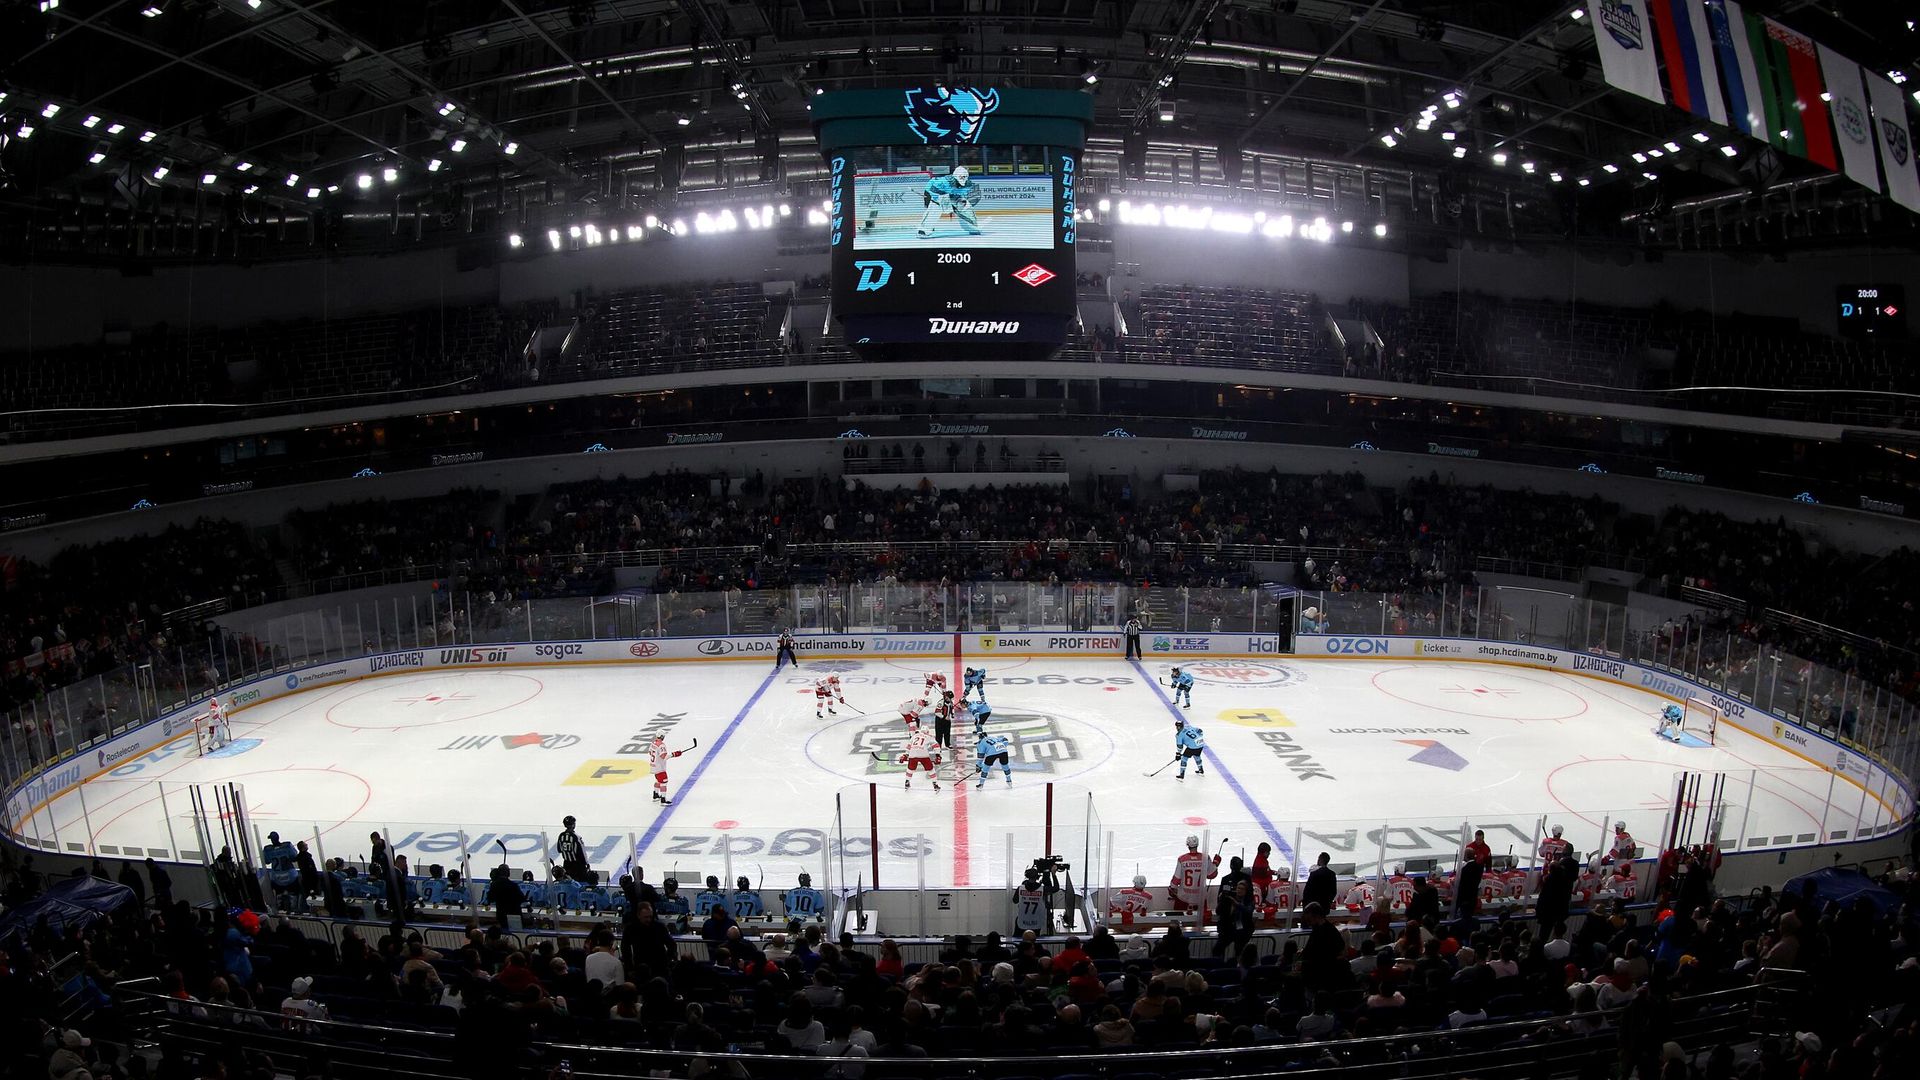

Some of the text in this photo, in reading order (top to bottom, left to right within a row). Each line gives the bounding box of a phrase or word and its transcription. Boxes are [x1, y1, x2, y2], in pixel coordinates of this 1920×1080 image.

[937, 253, 971, 264] 20:00
[907, 272, 915, 285] 1
[992, 272, 999, 285] 1
[1858, 289, 1878, 298] 20:00
[953, 301, 963, 309] nd
[1858, 307, 1862, 316] 1
[1875, 307, 1880, 316] 1
[737, 642, 774, 651] LADA
[873, 637, 946, 651] Dinamo
[999, 639, 1032, 647] BANK
[1173, 637, 1210, 645] TEZ
[1326, 638, 1389, 654] OZON
[535, 643, 582, 660] sogaz
[1478, 644, 1558, 664] shop.hcdinamo.by
[983, 674, 1135, 686] sogaz
[1711, 695, 1745, 719] sogaz
[1237, 713, 1272, 722] T
[615, 712, 688, 755] BANK
[1329, 727, 1470, 735] Rostelecom
[1775, 725, 1808, 748] T BANK
[913, 736, 925, 746] 21
[106, 742, 140, 763] Rostelecom
[1254, 731, 1337, 782] BANK
[591, 765, 632, 778] T
[27, 763, 80, 805] Dinamo
[663, 828, 934, 858] sogaz
[1301, 823, 1534, 852] LADA
[1184, 869, 1201, 887] 67
[424, 887, 433, 901] 9
[795, 896, 811, 912] 10
[940, 898, 948, 907] 6
[1023, 902, 1039, 915] 77
